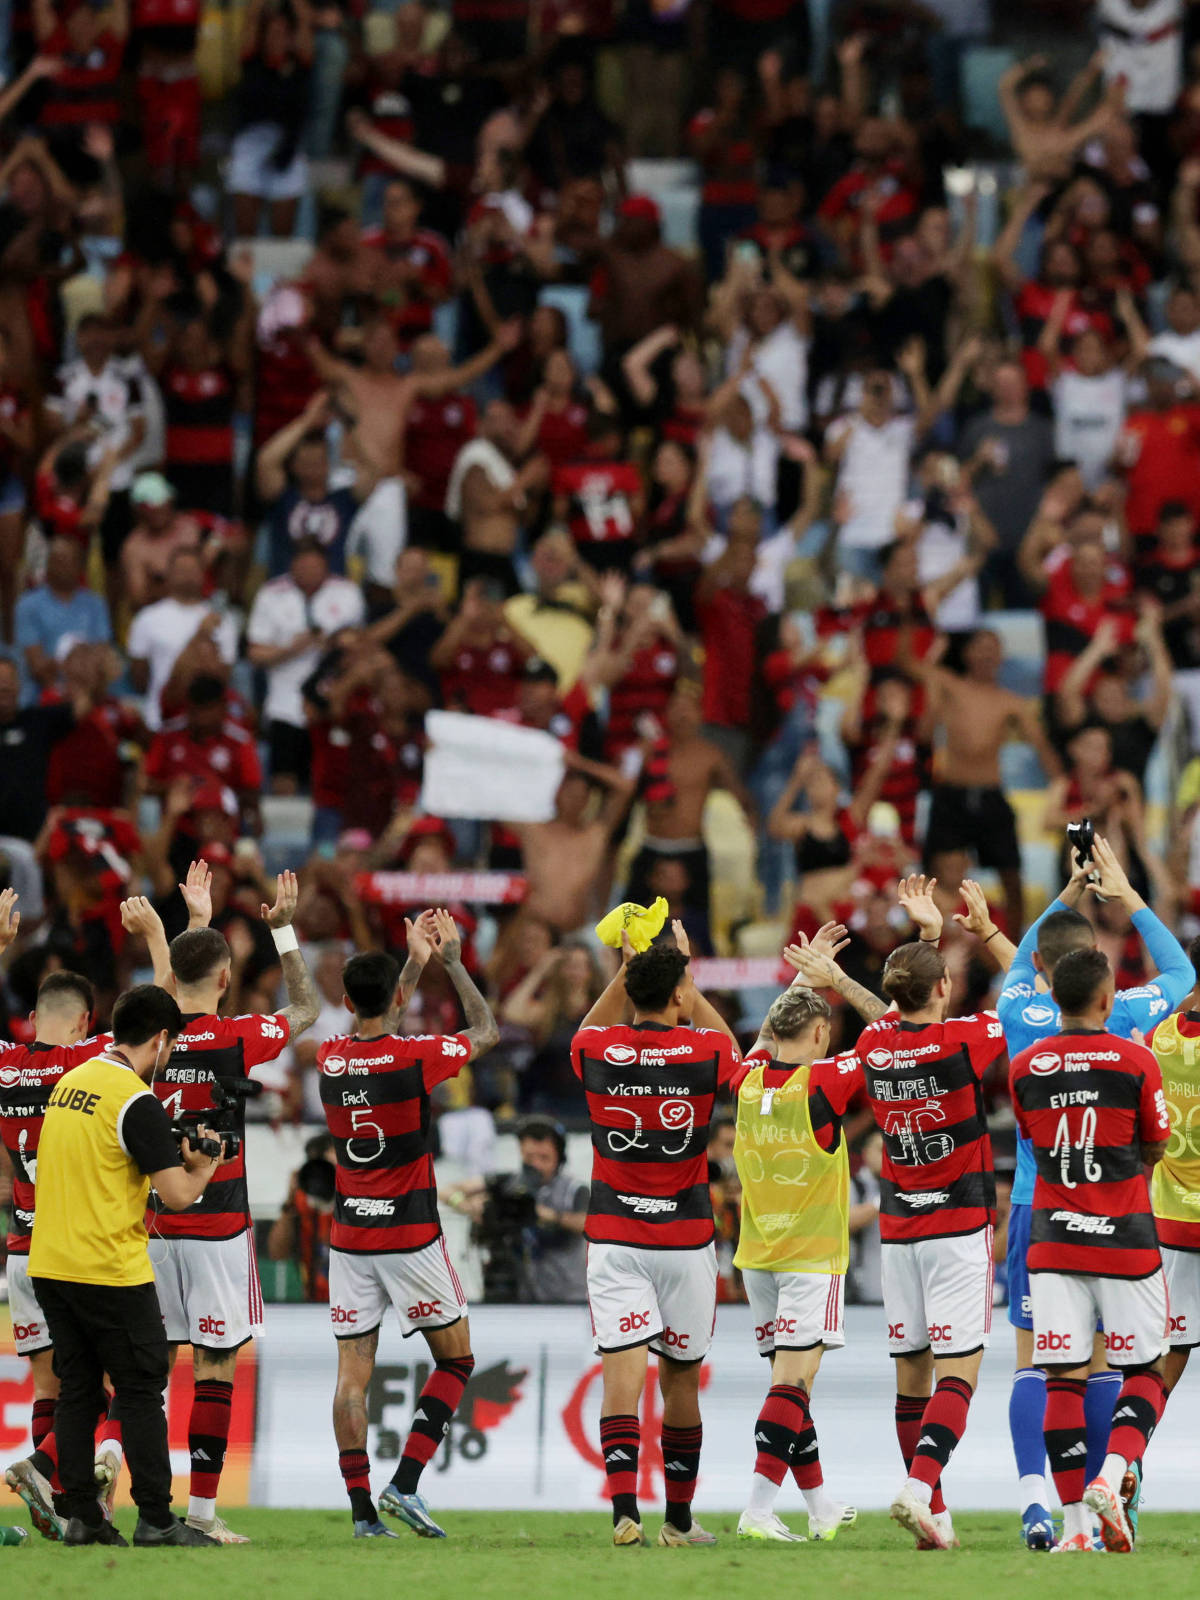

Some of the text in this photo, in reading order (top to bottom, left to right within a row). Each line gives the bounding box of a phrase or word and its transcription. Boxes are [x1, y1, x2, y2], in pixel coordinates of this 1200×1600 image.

[641, 1045, 693, 1057] mercado
[894, 1043, 940, 1058] mercado
[1064, 1051, 1120, 1062] mercado
[349, 1055, 394, 1066] mercado
[640, 1056, 666, 1066] livre
[894, 1058, 916, 1070] livre
[1064, 1061, 1090, 1072] livre
[21, 1065, 63, 1076] mercado
[348, 1066, 369, 1075] livre
[20, 1076, 42, 1087] livre
[658, 1086, 690, 1096] HUGO
[874, 1079, 928, 1101] FILIPE
[1050, 1090, 1099, 1110] EVERTON
[604, 1099, 695, 1155] 29
[346, 1109, 385, 1162] 5
[343, 1198, 394, 1208] ASSIST
[1050, 1211, 1110, 1226] ASSIST
[1066, 1221, 1115, 1235] CARD
[331, 1305, 358, 1323] abc
[408, 1300, 443, 1319] abc
[199, 1315, 225, 1336] abc
[619, 1310, 650, 1332] abc
[1037, 1330, 1071, 1350] abc
[1104, 1332, 1135, 1351] abc
